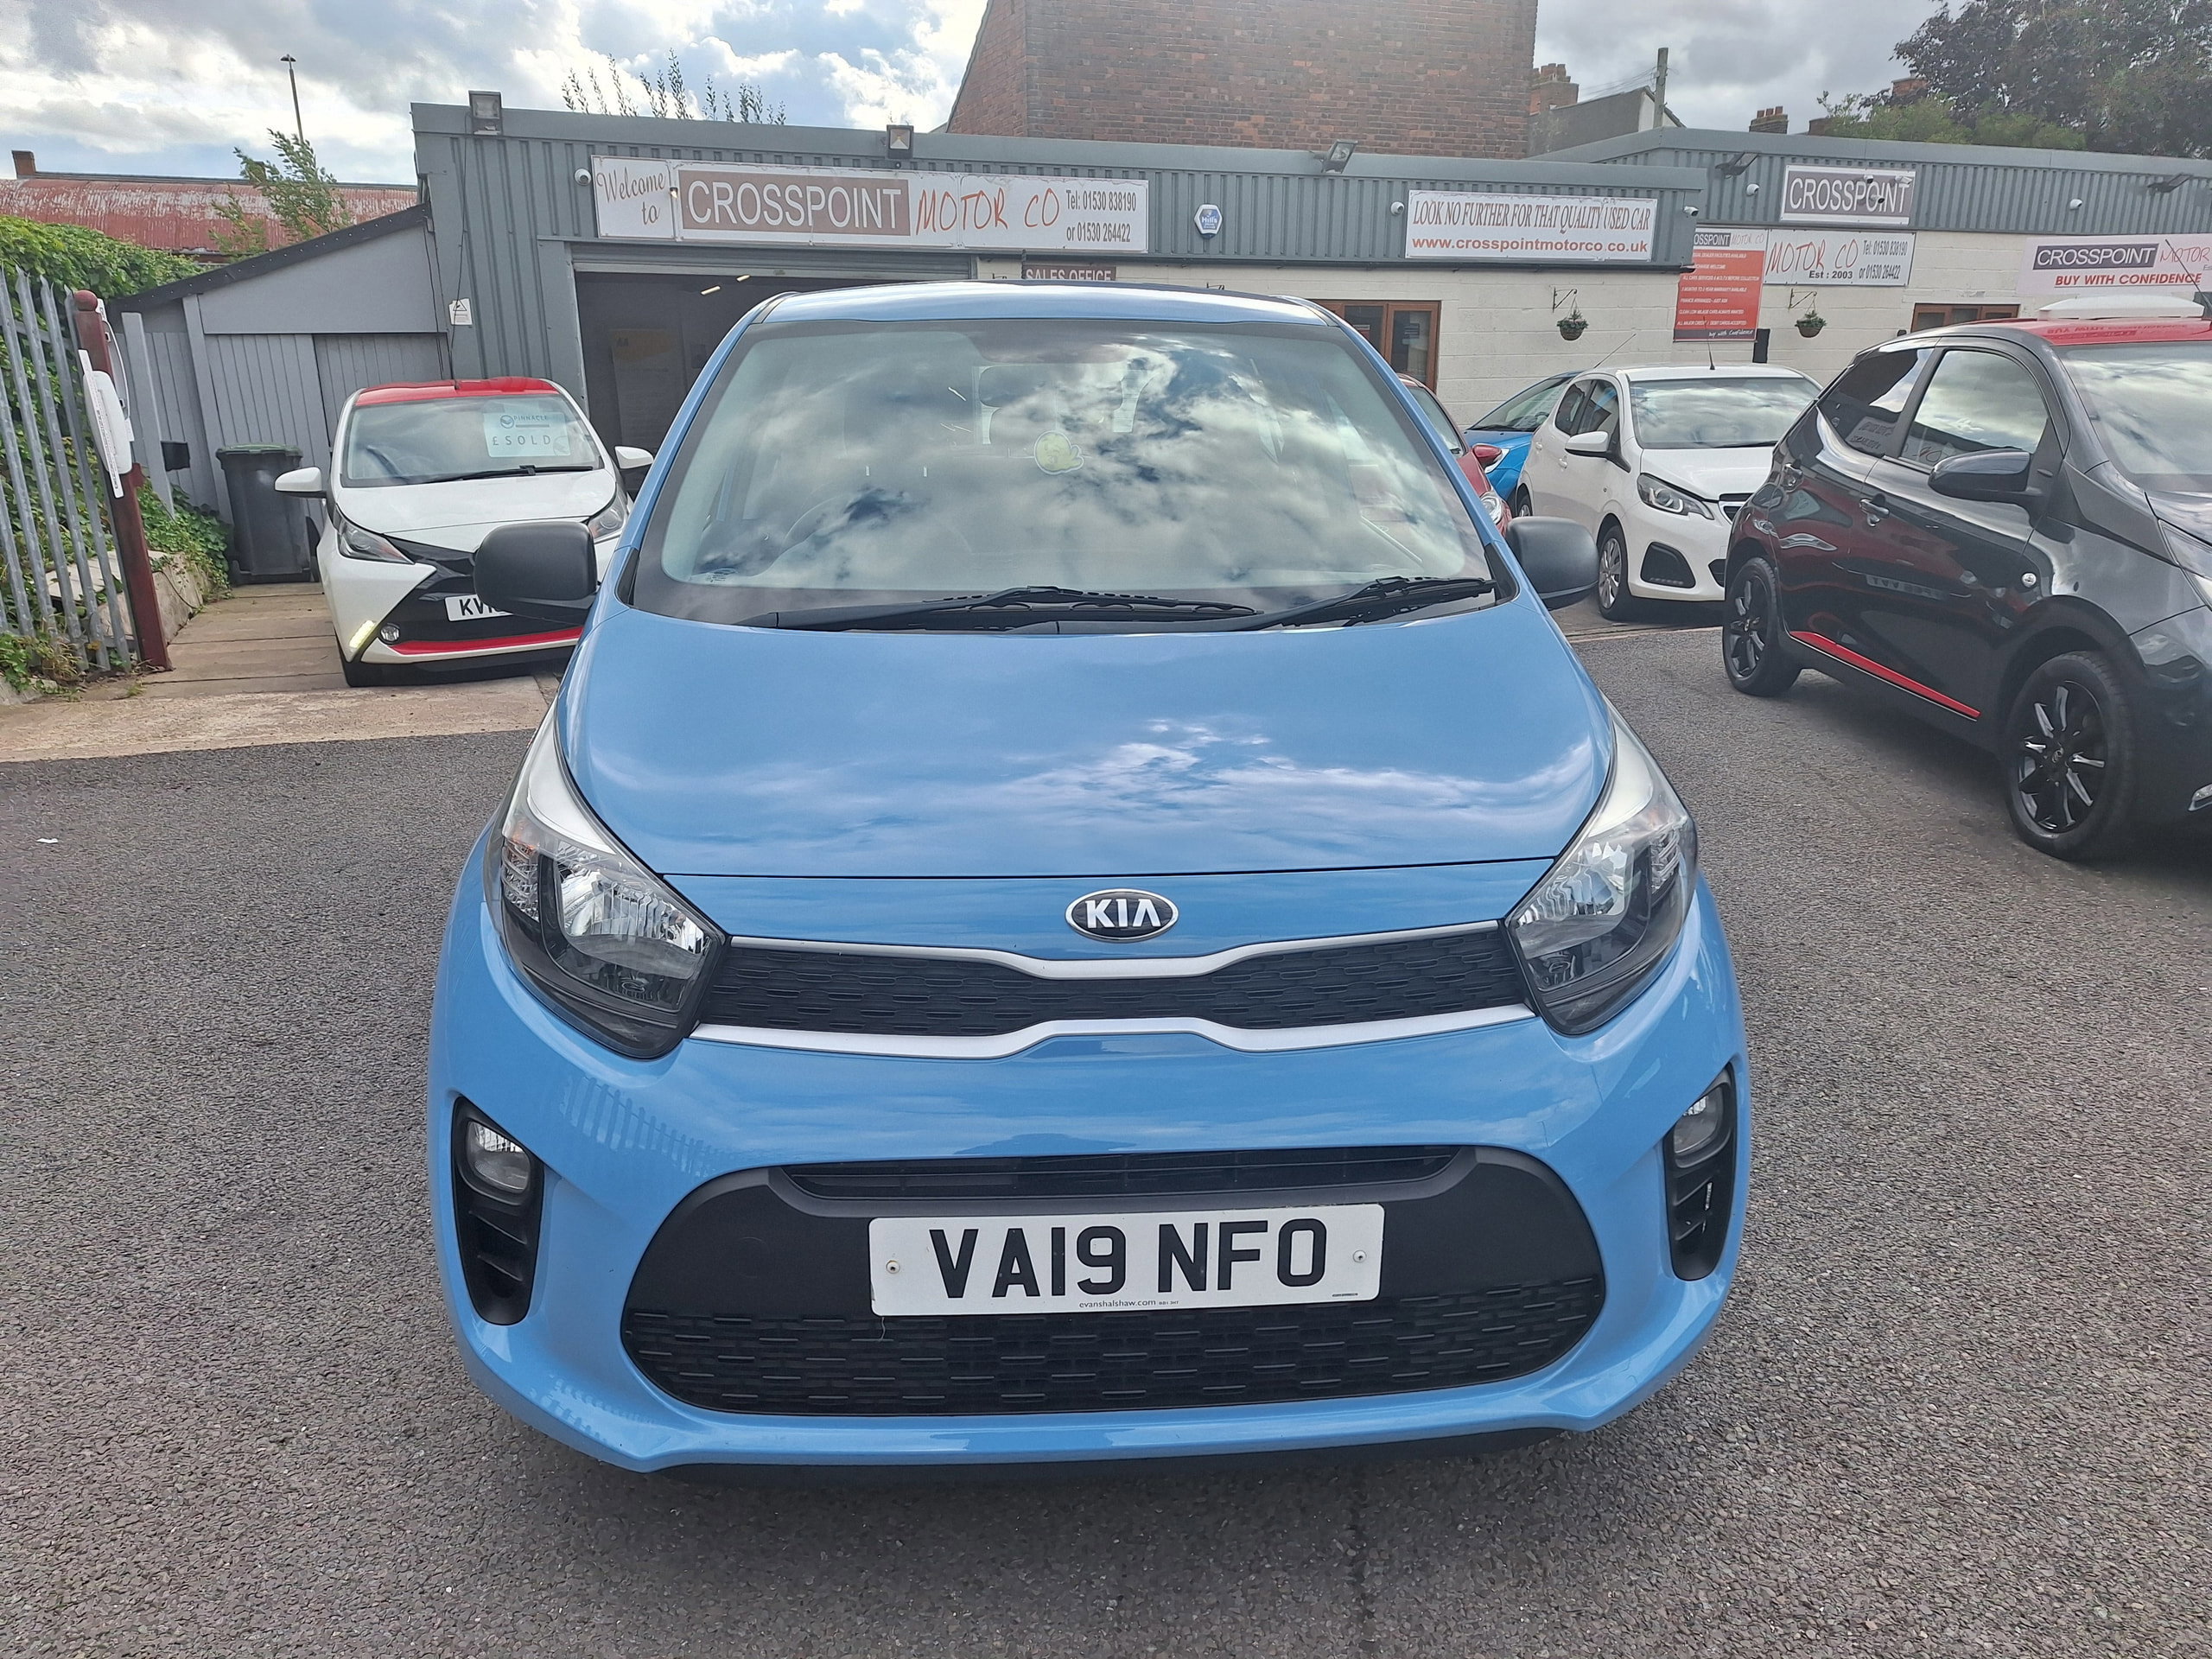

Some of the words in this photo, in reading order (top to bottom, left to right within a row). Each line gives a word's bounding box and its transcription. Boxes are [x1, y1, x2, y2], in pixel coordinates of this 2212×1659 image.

[596, 167, 665, 203] Welcome
[1789, 177, 1910, 213] CROSSPOINT
[688, 180, 901, 229] CROSSPOINT
[916, 188, 1008, 235] MOTOR
[1024, 188, 1060, 228] CO
[1065, 189, 1081, 210] Tel:
[1083, 190, 1106, 211] 01530
[1109, 191, 1136, 212] 838190
[641, 201, 660, 225] to
[1413, 200, 1445, 225] LOOK
[1445, 201, 1461, 226] NO
[1462, 202, 1510, 226] FURTHER
[1510, 203, 1533, 227] FOR
[1533, 205, 1560, 228] THAT
[1560, 205, 1604, 234] QUALITY
[1604, 207, 1630, 230] USED
[1630, 207, 1651, 230] CAR
[1066, 226, 1075, 241] or
[1077, 221, 1101, 242] 01530
[1103, 222, 1131, 242] 264422
[1694, 233, 1731, 245] OSSPOINT
[1764, 239, 1826, 276] MOTOR
[1834, 238, 1859, 269] CO
[2037, 247, 2156, 266] CROSSPOINT
[2160, 247, 2210, 263] MOTOR
[1026, 269, 1065, 280] SALES
[1069, 270, 1112, 281] OFFICE
[1831, 270, 1853, 279] 2003
[2055, 275, 2081, 286] BUY
[2084, 274, 2115, 285] WITH
[2119, 273, 2202, 285] CONFIDENCE
[1085, 899, 1161, 928] KIA
[929, 1225, 1127, 1299] VA19
[1159, 1218, 1327, 1293] NFO
[1079, 1299, 1156, 1308] evanshalshaw.com
